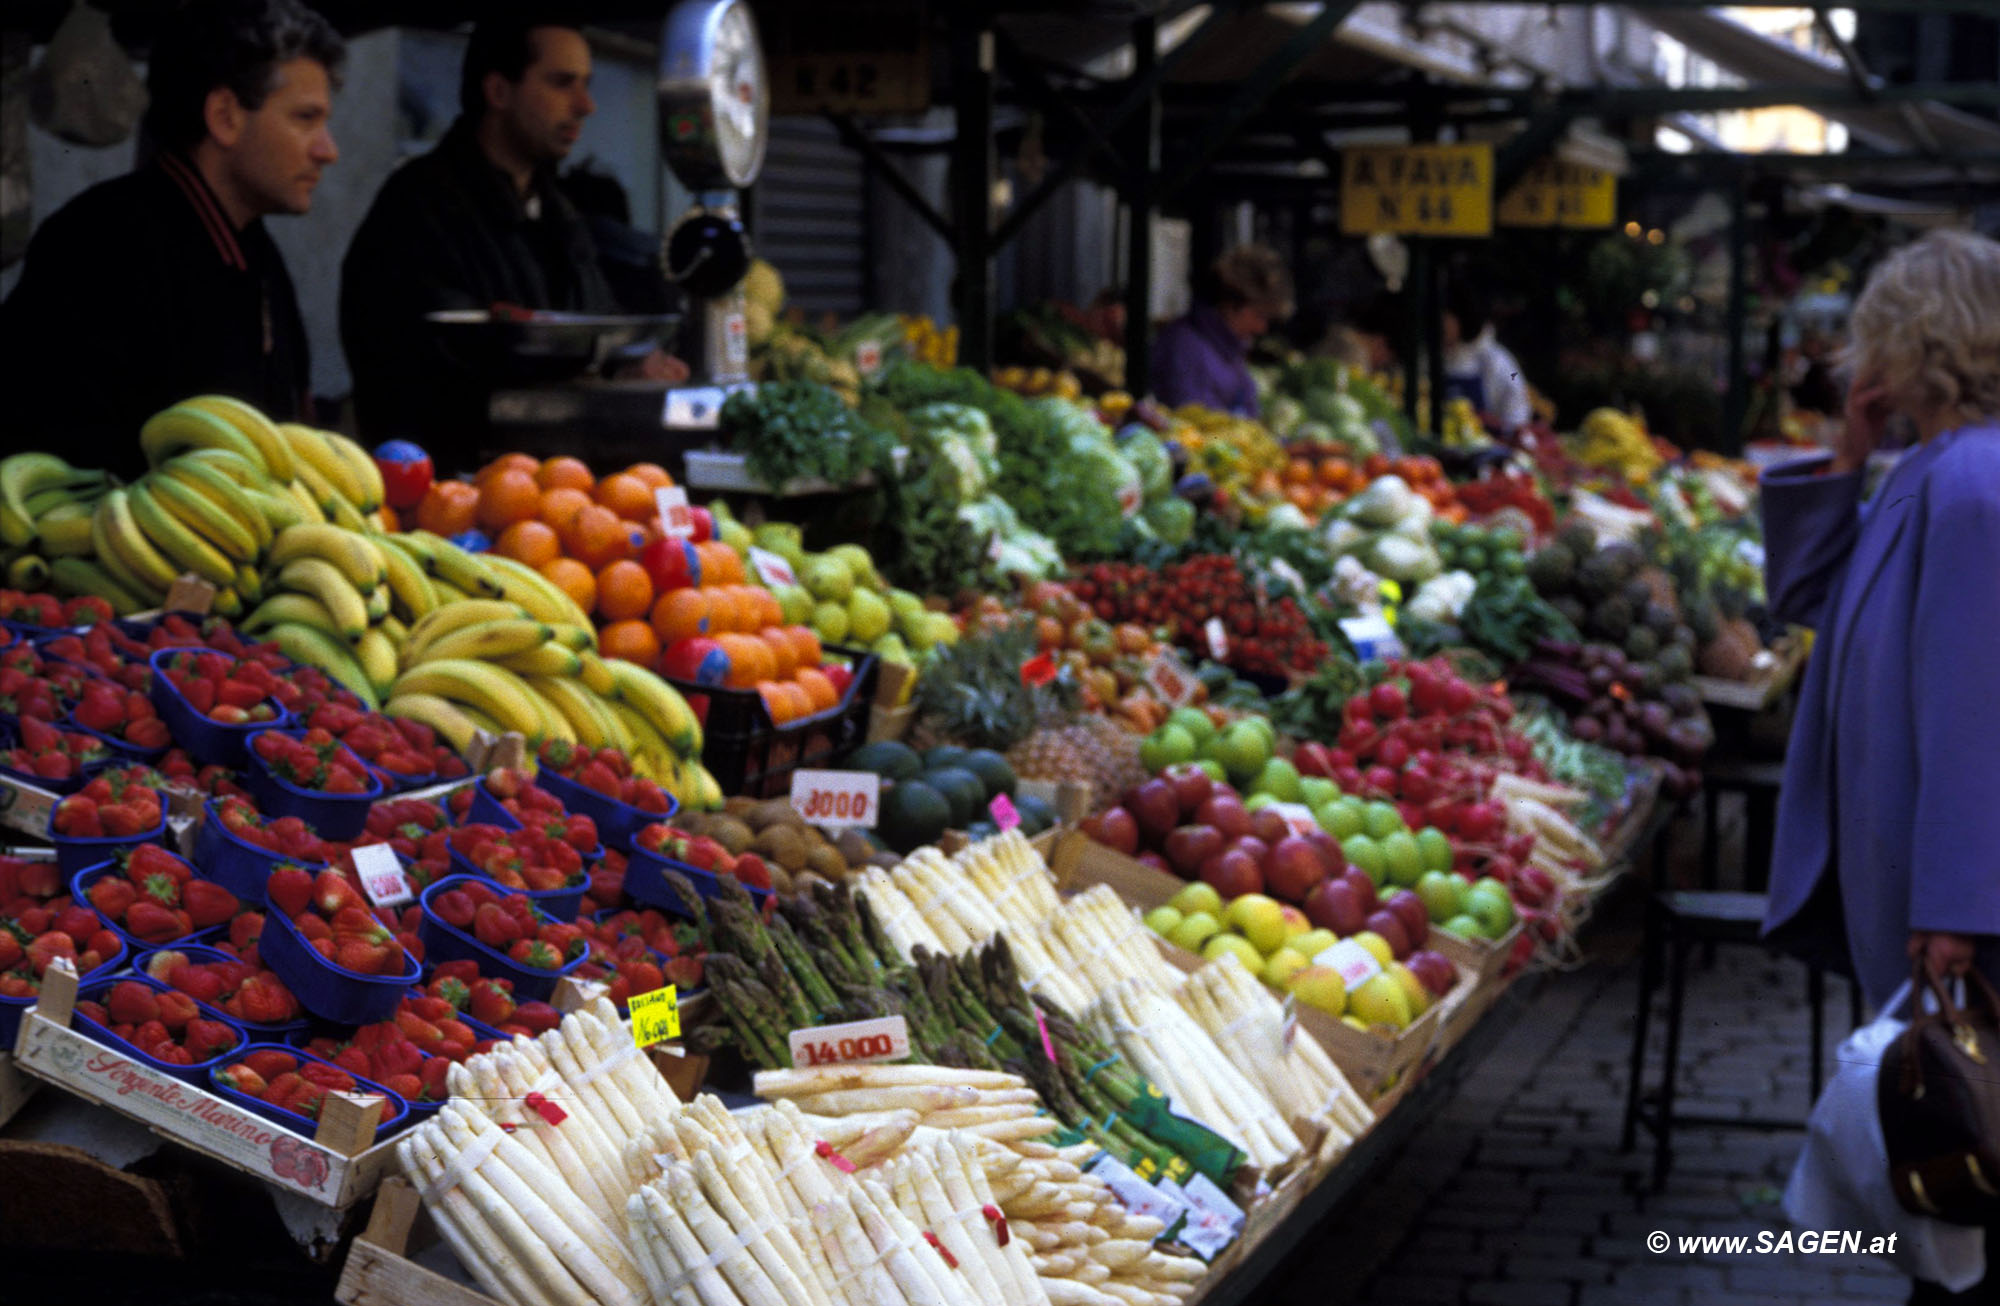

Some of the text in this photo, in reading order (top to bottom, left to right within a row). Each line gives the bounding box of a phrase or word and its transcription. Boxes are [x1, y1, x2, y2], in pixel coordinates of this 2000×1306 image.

[803, 788, 868, 820] 3000
[803, 1033, 893, 1067] 14000
[86, 1051, 183, 1106] Sorgente
[175, 1097, 273, 1146] Marino
